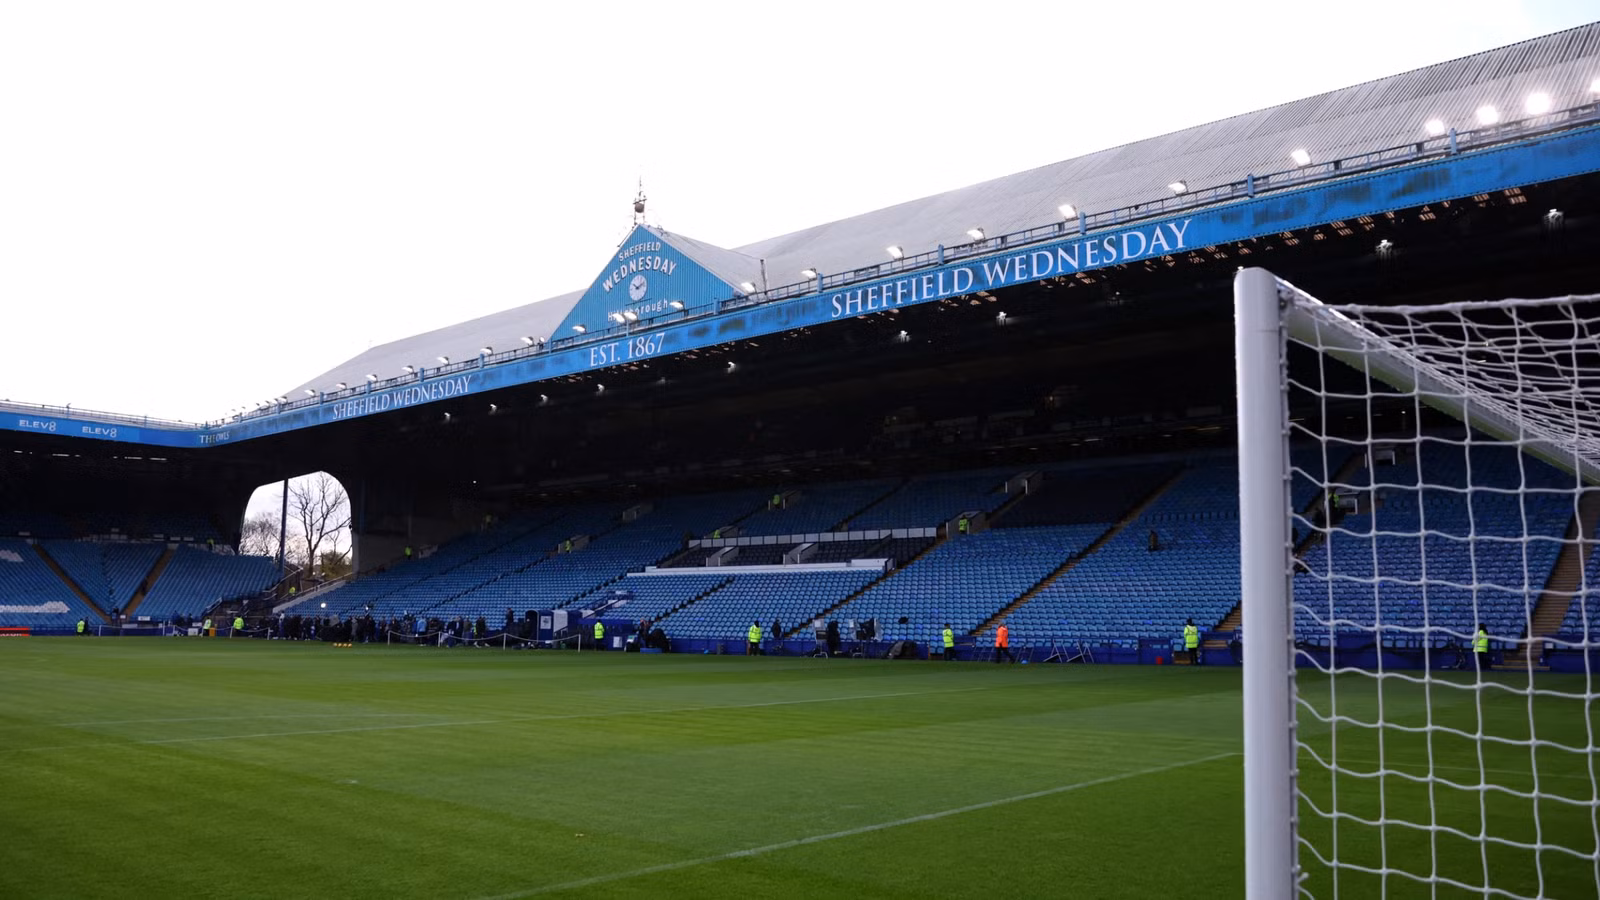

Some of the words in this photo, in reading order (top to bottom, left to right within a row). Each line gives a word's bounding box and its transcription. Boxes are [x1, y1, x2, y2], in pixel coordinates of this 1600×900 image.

[619, 241, 661, 262] SHEFFIELD
[831, 268, 974, 318] SHEFFIELD
[983, 219, 1193, 287] WEDNESDAY
[603, 256, 676, 292] WEDNESDAY
[590, 341, 621, 367] EST.
[627, 332, 665, 358] 1867
[333, 394, 390, 419] SHEFFIELD
[393, 375, 471, 408] WEDNESDAY
[19, 419, 56, 432] ELEV8
[82, 426, 117, 438] ELEV8
